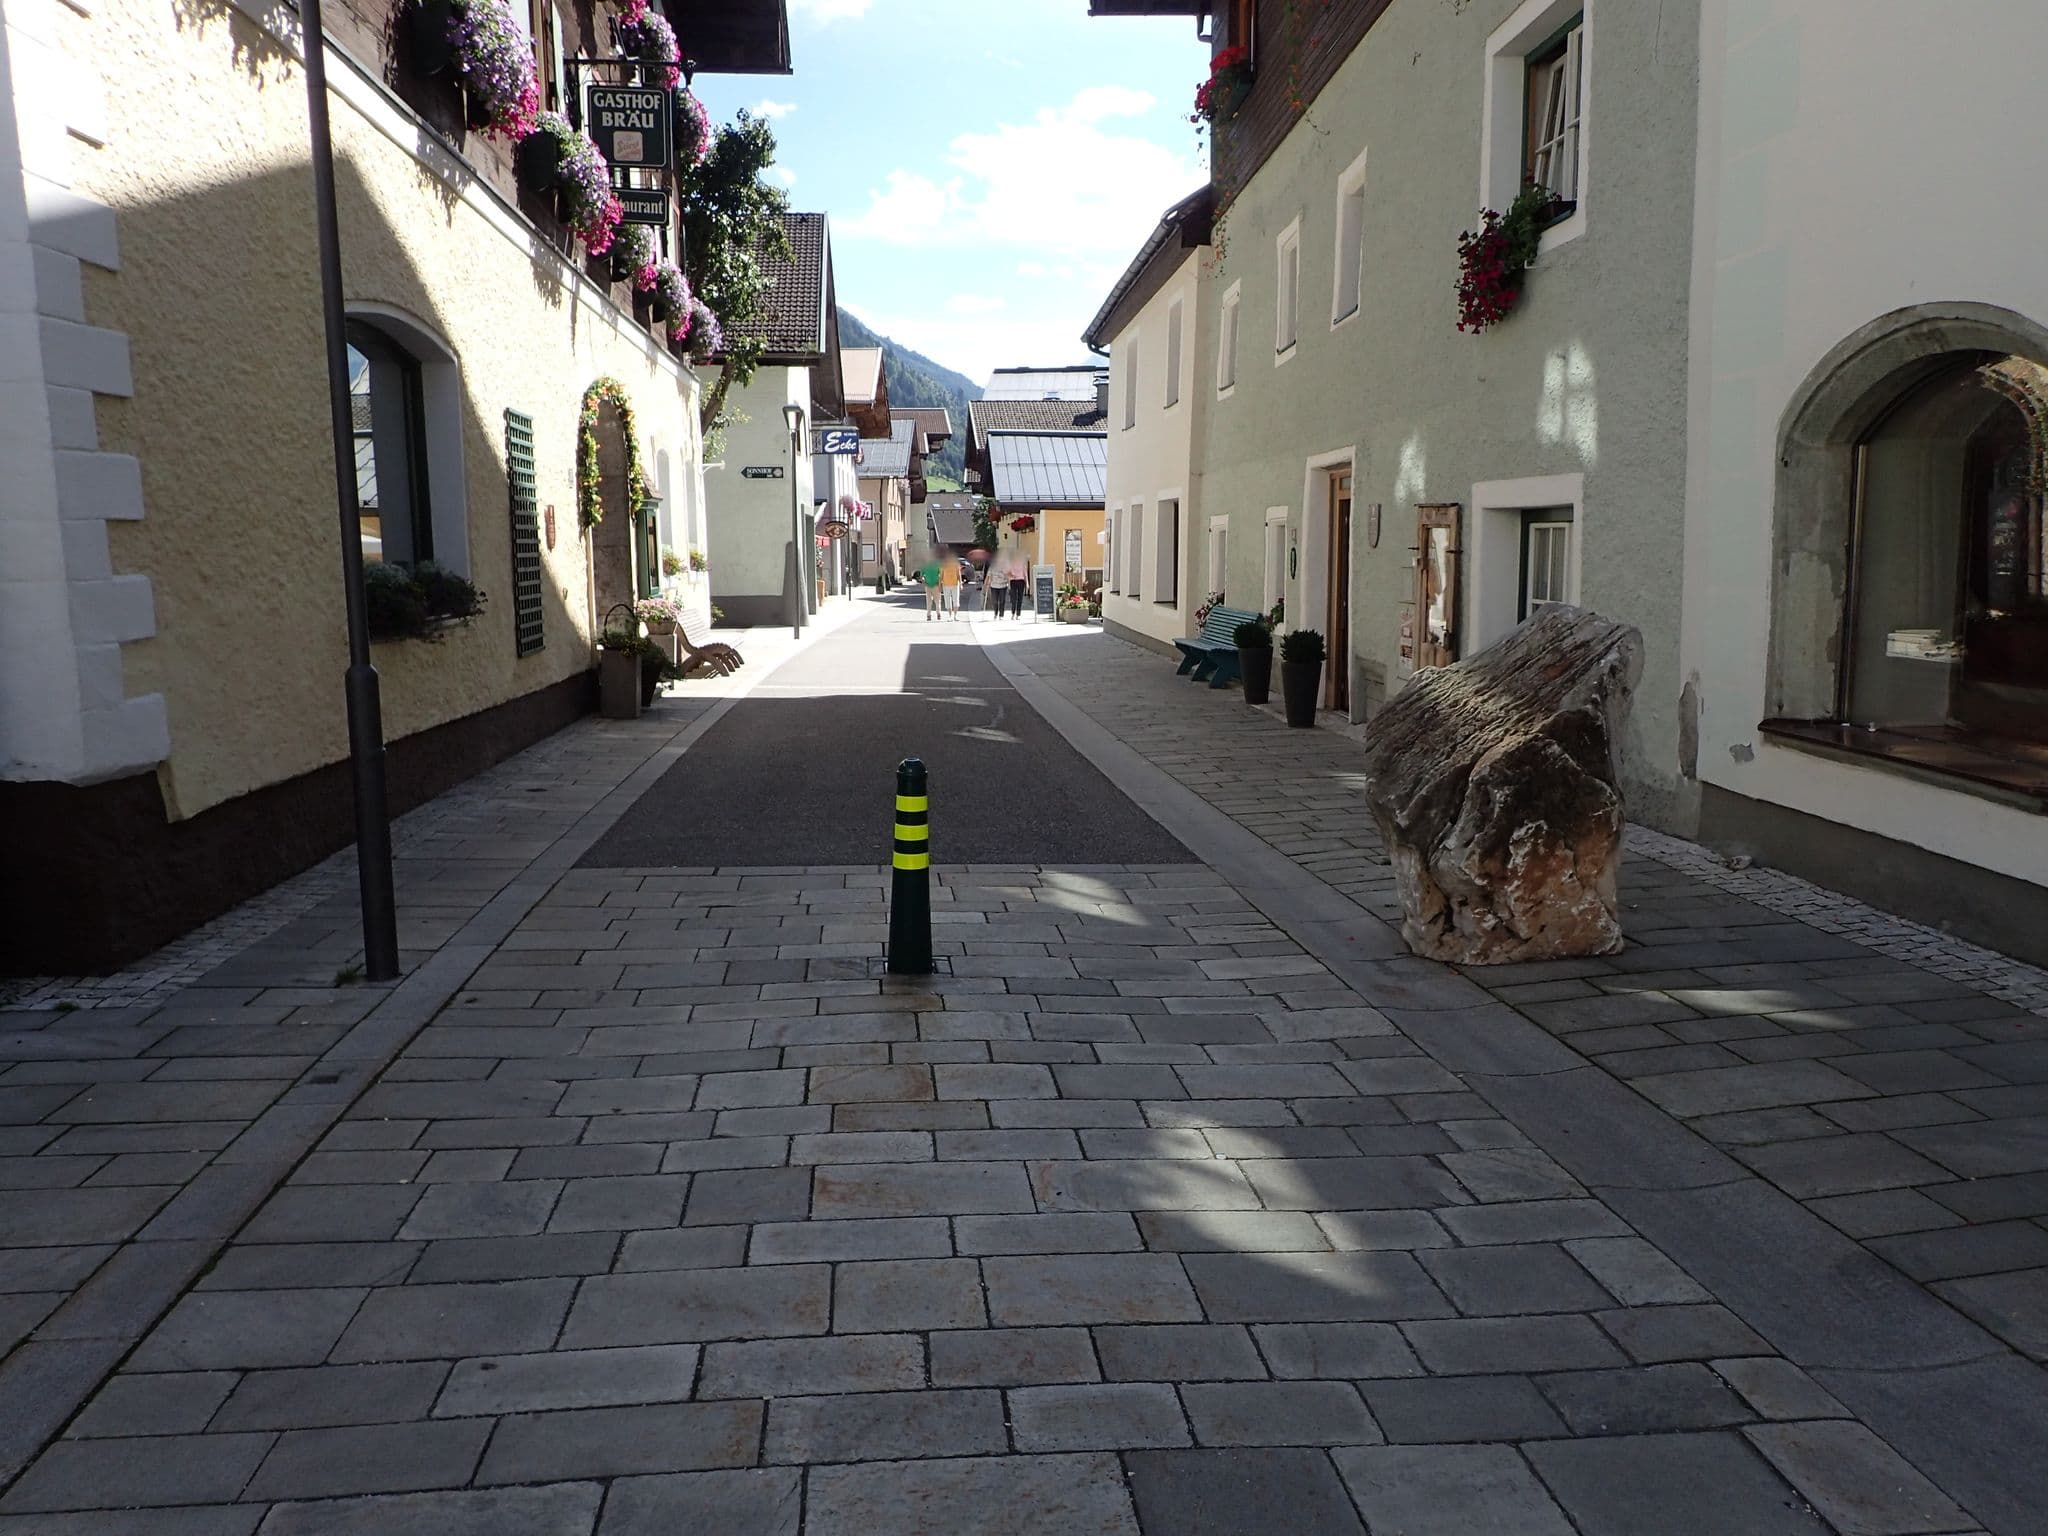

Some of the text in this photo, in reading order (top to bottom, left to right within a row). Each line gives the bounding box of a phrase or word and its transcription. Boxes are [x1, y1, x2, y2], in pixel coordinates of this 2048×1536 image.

[593, 92, 661, 109] GASTHOF
[602, 110, 654, 128] BRÄU
[623, 200, 664, 215] aurant
[824, 431, 856, 453] Ecke
